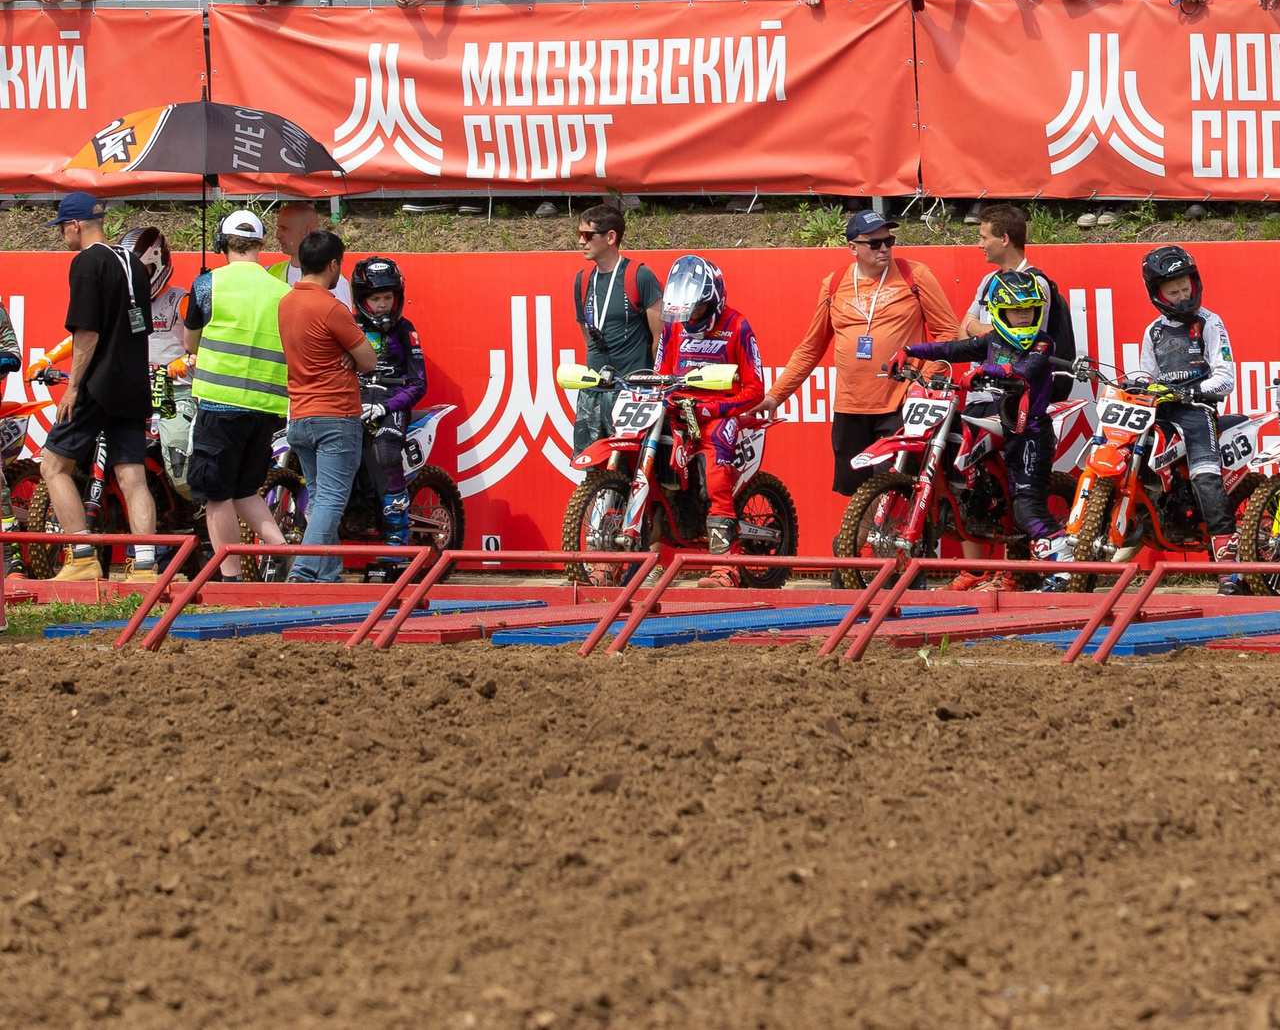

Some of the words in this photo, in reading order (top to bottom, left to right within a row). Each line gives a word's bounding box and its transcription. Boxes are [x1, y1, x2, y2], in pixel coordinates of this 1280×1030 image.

[462, 20, 788, 108] МОСКОВСКИЙ
[464, 114, 614, 181] СПОРТ
[679, 338, 728, 353] LEATT
[615, 402, 658, 428] 56
[904, 402, 948, 427] 185
[1100, 403, 1152, 431] 613
[1220, 434, 1253, 468] 613
